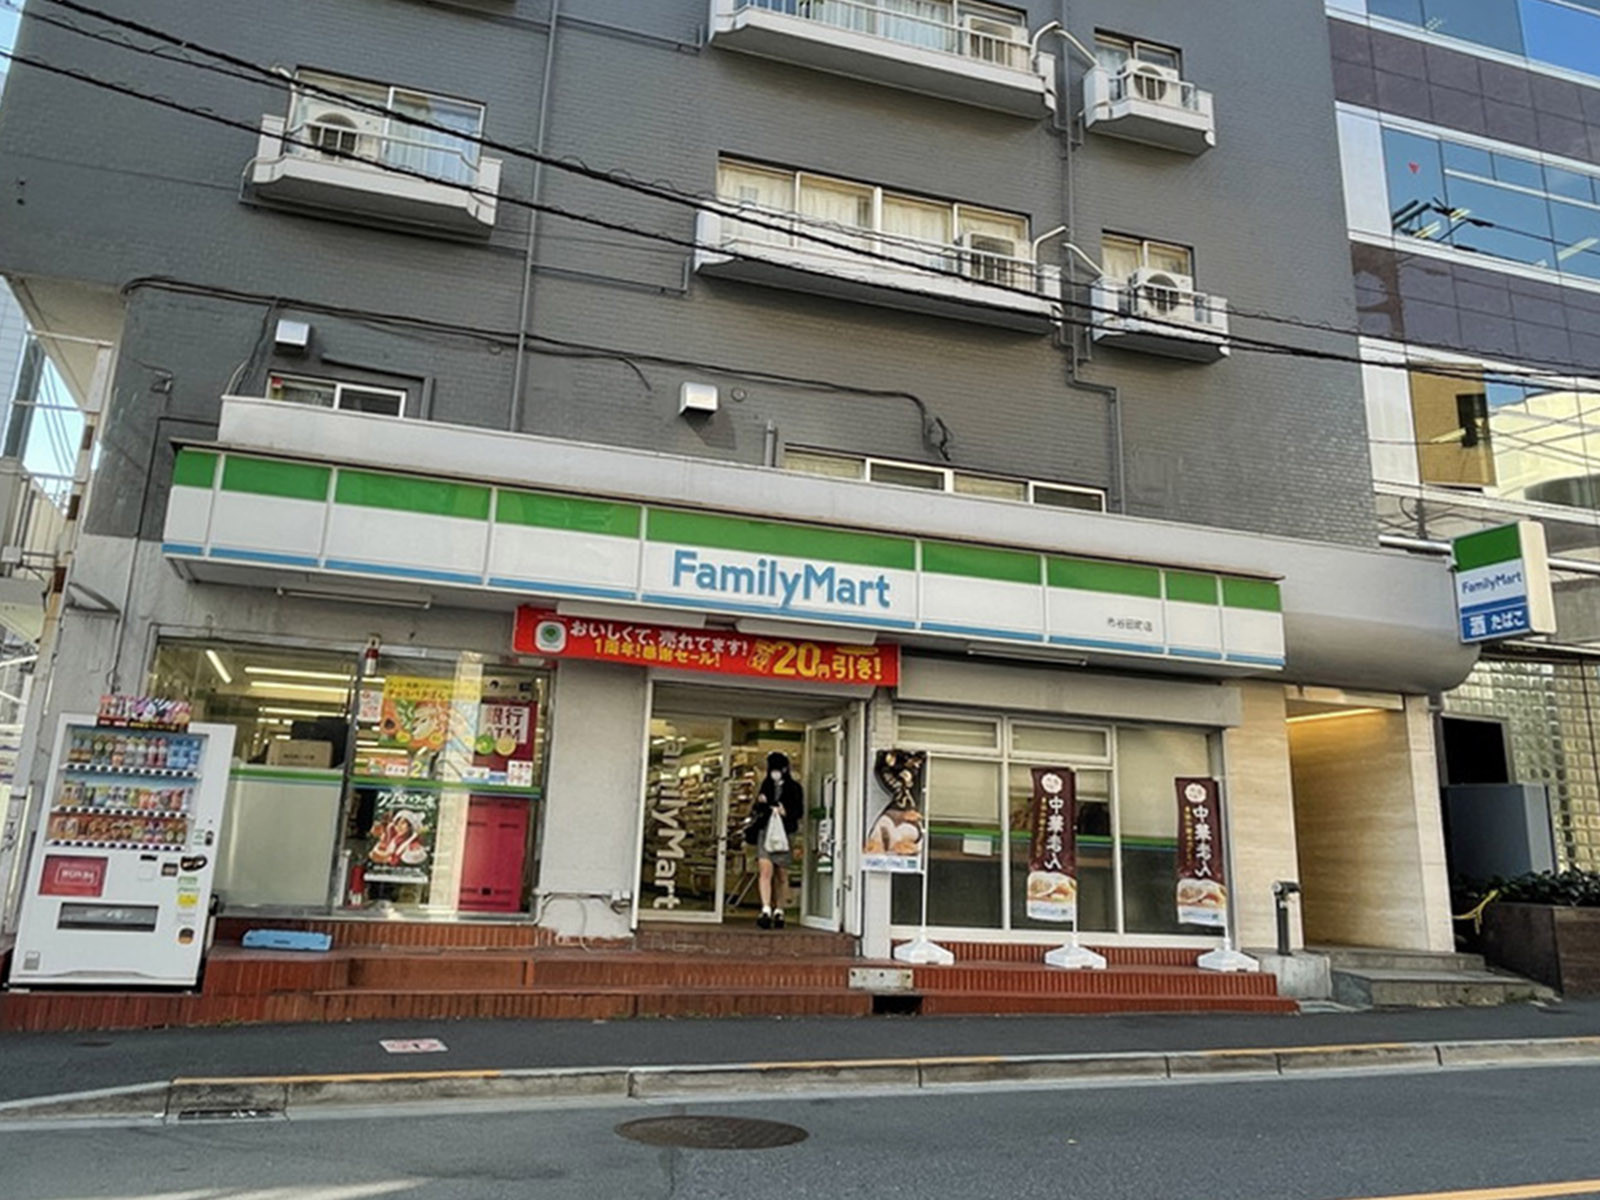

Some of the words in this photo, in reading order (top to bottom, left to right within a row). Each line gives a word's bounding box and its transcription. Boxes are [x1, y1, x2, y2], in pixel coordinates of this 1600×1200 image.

[673, 550, 891, 608] FamilyMart
[1462, 571, 1522, 594] FamilyMart
[1491, 611, 1525, 631] たばこ
[651, 741, 688, 910] amilyMart
[1044, 796, 1065, 870] 中華まん
[1192, 805, 1213, 877] 中華まん
